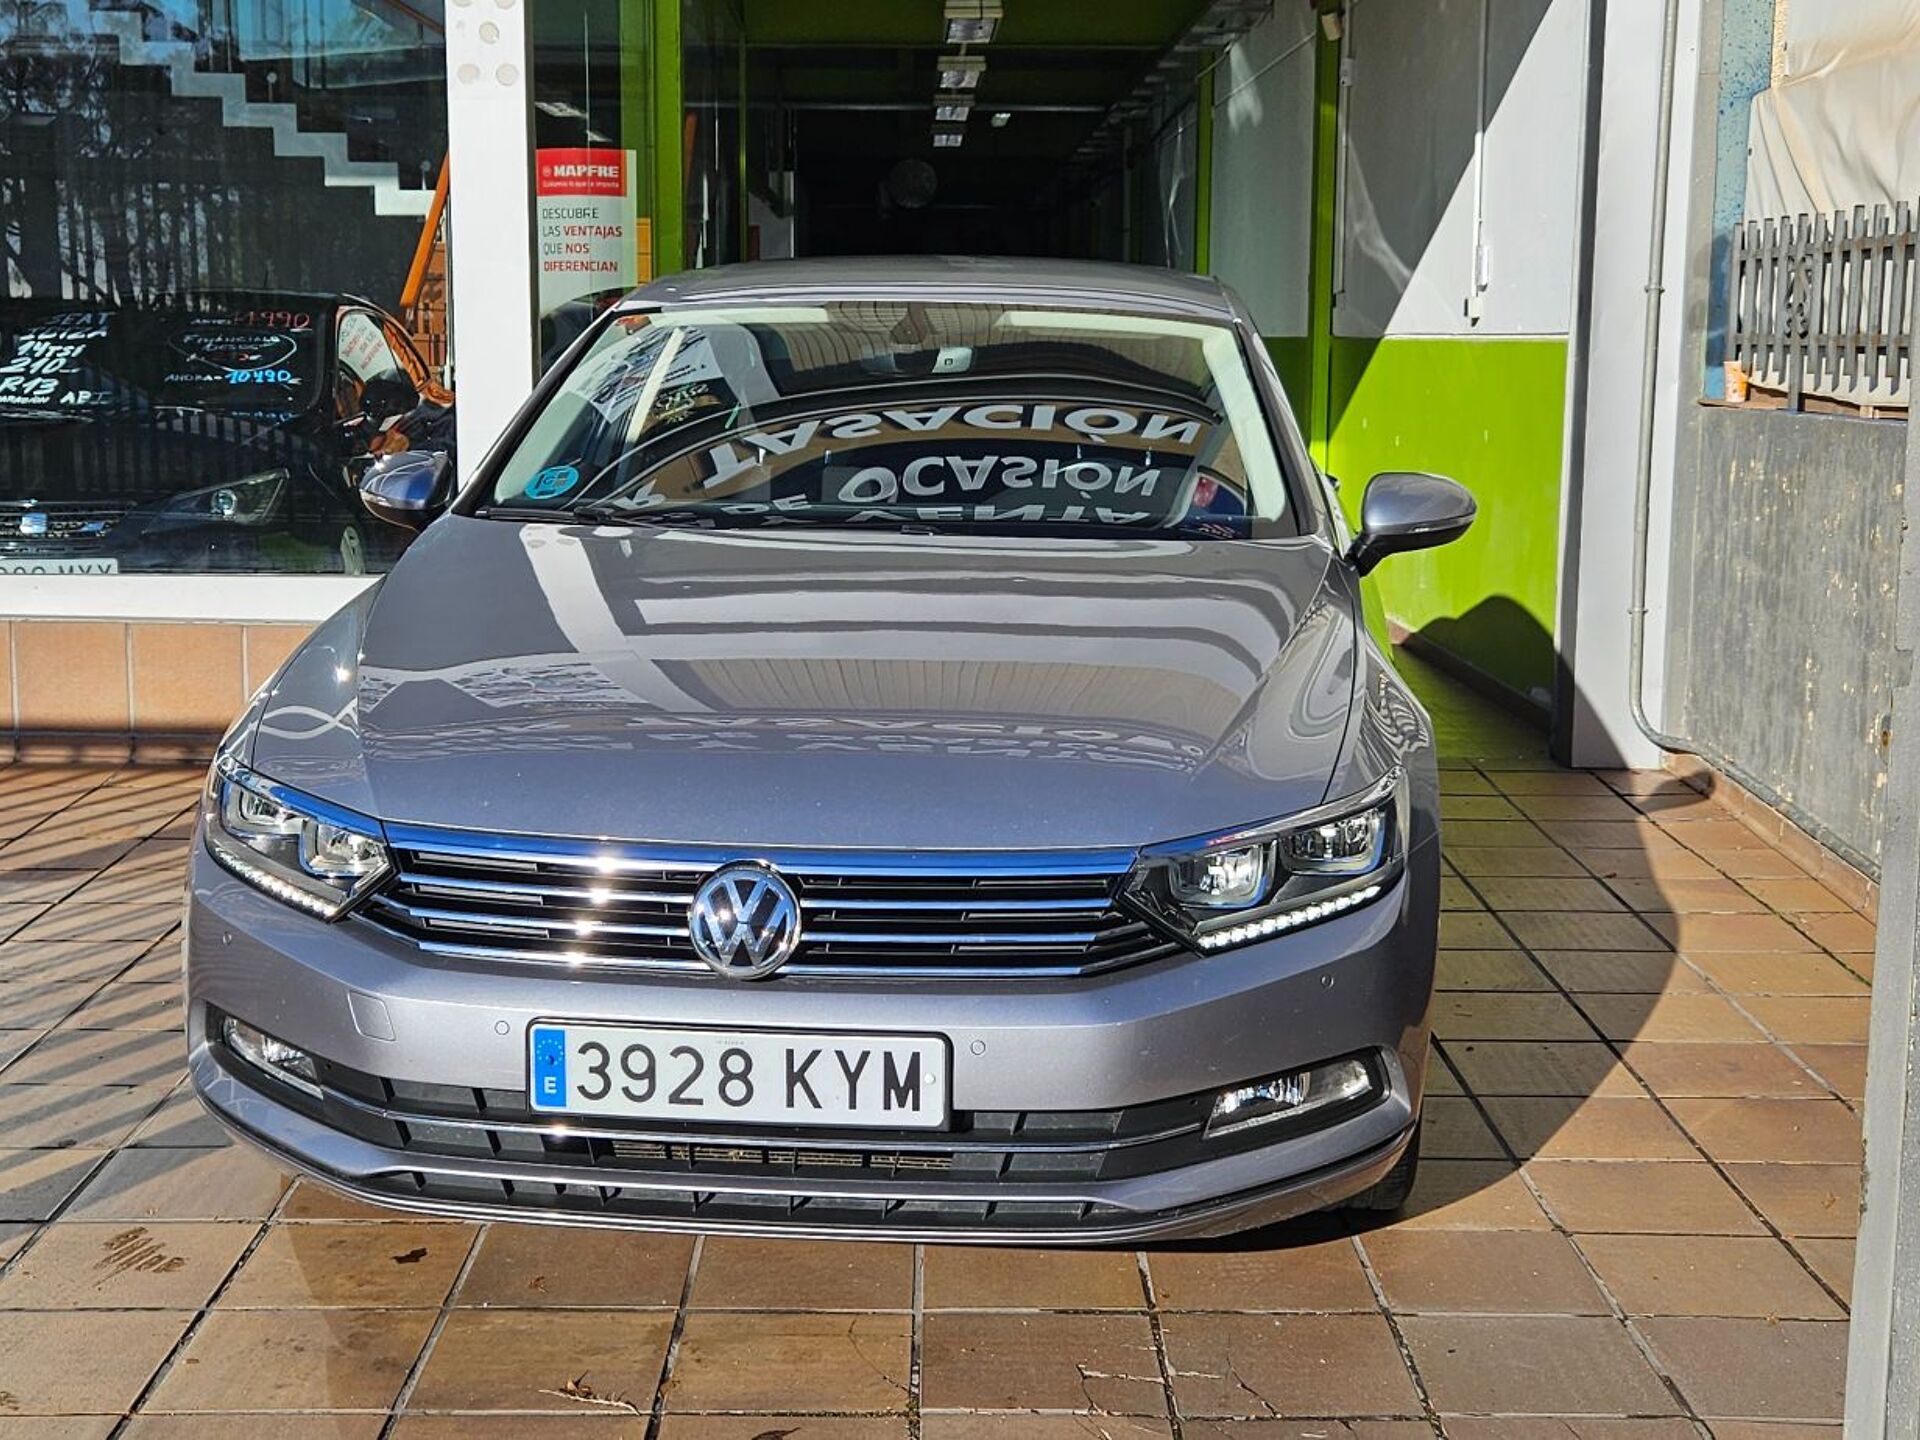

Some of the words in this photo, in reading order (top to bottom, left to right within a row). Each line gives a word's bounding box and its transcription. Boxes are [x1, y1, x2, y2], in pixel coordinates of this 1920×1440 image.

[553, 164, 619, 177] MAPFRE
[542, 207, 599, 219] DESCUBRE
[542, 226, 561, 237] LAS
[563, 226, 623, 239] VENTAJAS
[544, 243, 562, 255] QUE
[565, 243, 590, 253] NOS
[543, 260, 619, 272] DIFERENCIAN
[543, 1076, 557, 1094] E
[576, 1041, 754, 1108] 3928
[785, 1048, 921, 1112] KYM
